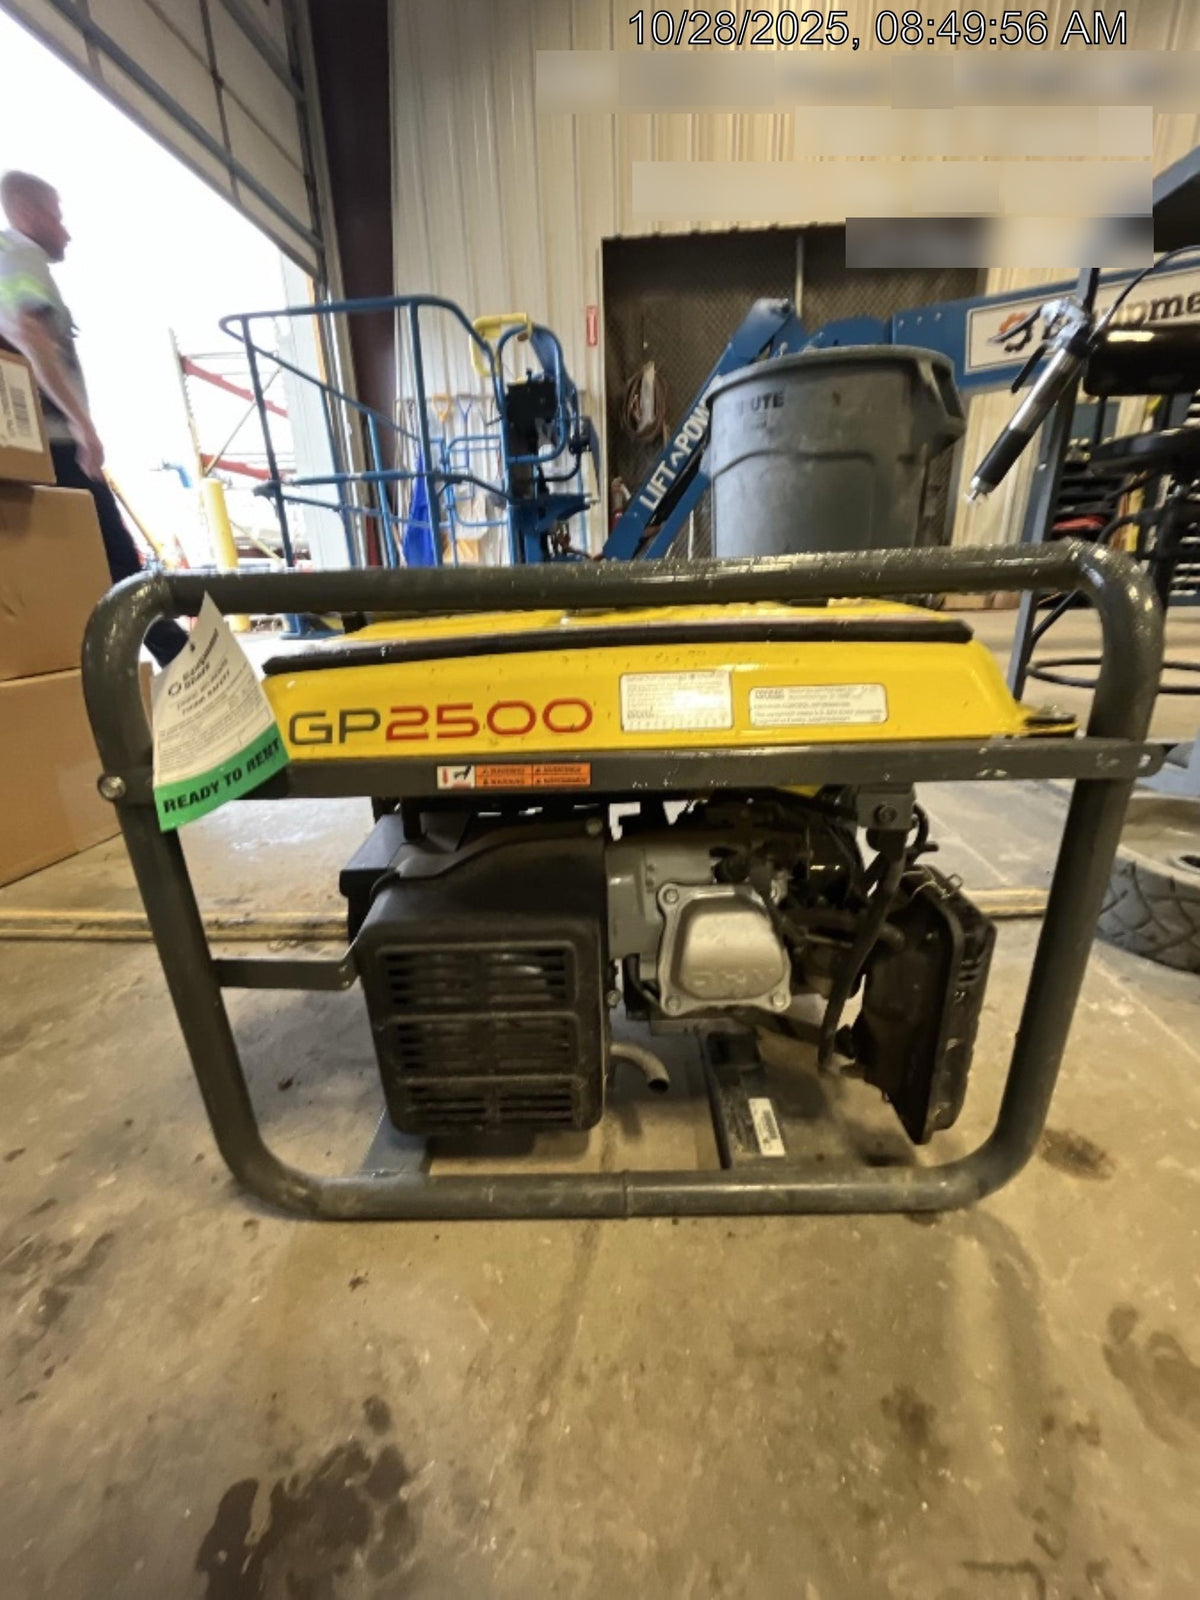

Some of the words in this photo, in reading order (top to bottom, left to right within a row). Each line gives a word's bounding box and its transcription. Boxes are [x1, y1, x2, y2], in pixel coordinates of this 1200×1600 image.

[639, 459, 676, 512] LIFT
[289, 698, 593, 746] GP2500
[162, 779, 220, 814] READY
[223, 767, 243, 787] TO
[246, 738, 280, 774] RENT
